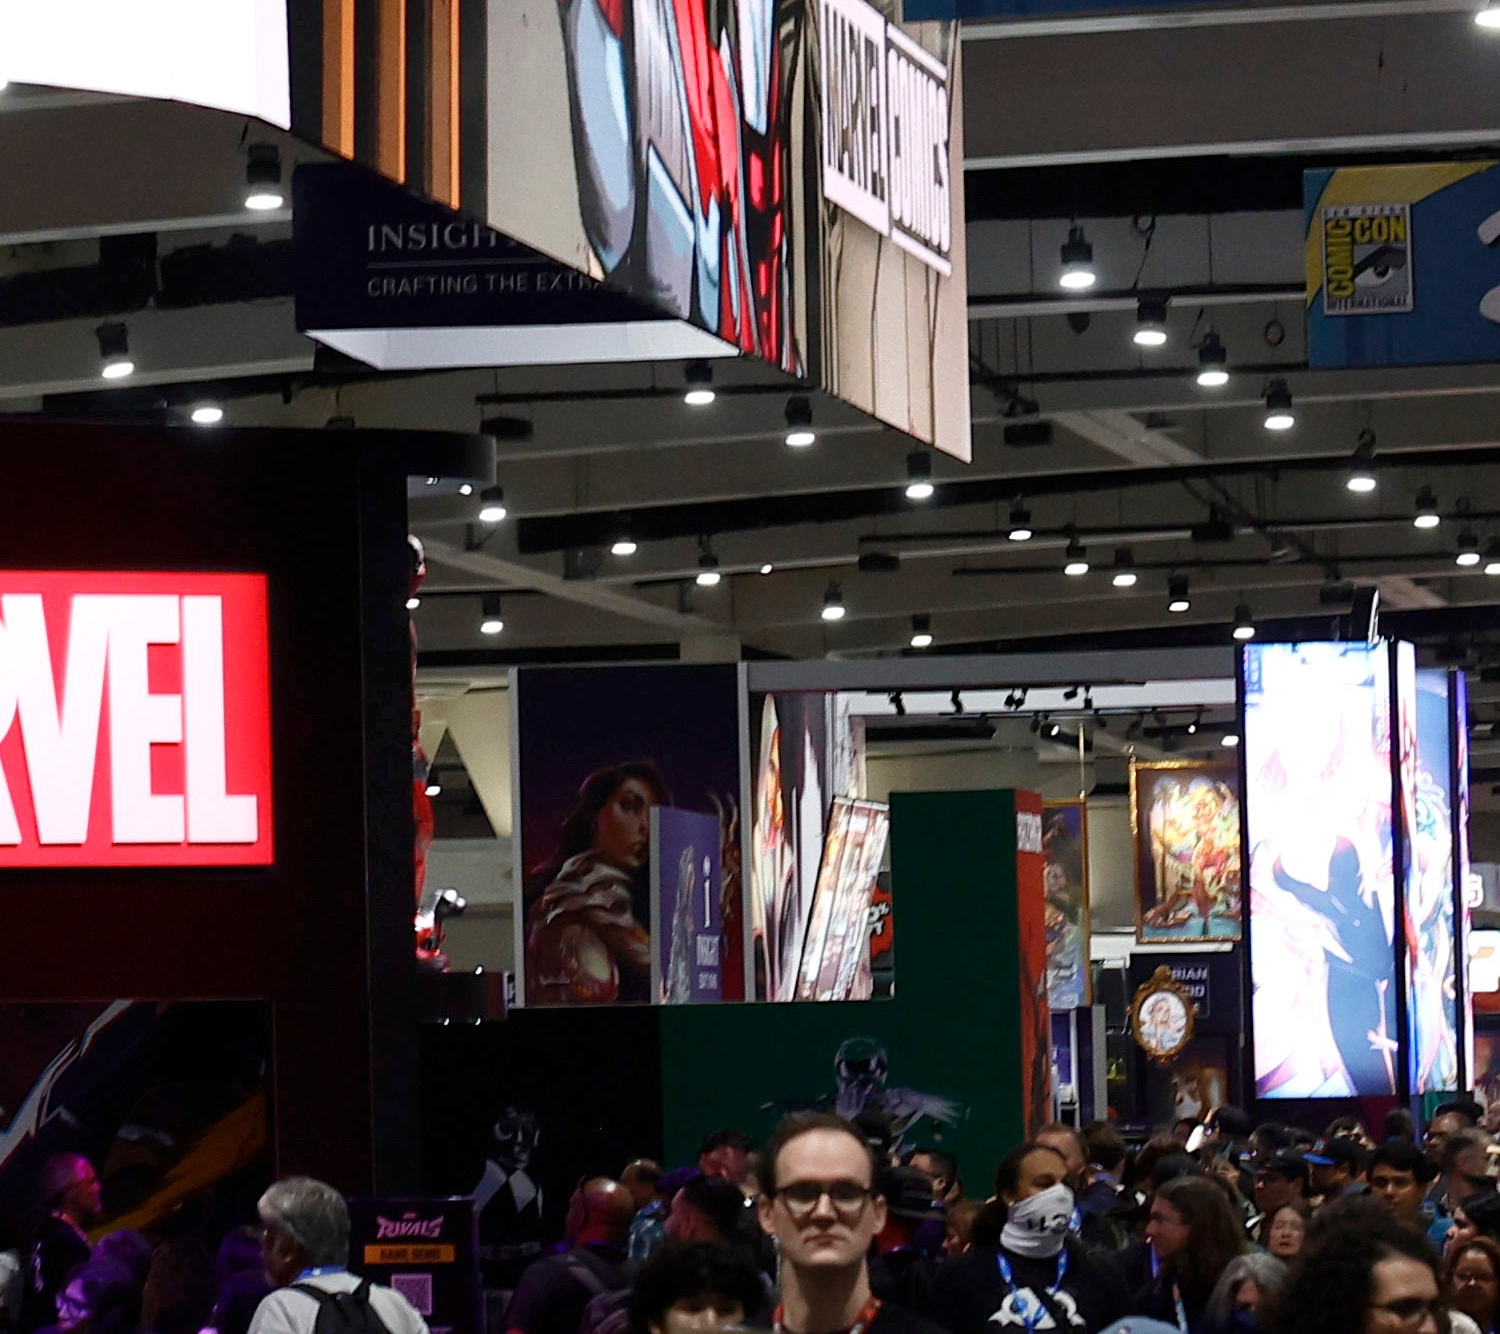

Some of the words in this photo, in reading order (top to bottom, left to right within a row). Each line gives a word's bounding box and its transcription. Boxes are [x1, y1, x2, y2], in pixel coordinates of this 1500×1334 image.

[1353, 216, 1406, 244] CON
[367, 274, 479, 297] CRAFTING
[484, 272, 529, 293] THE
[375, 1214, 445, 1239] RIVALS
